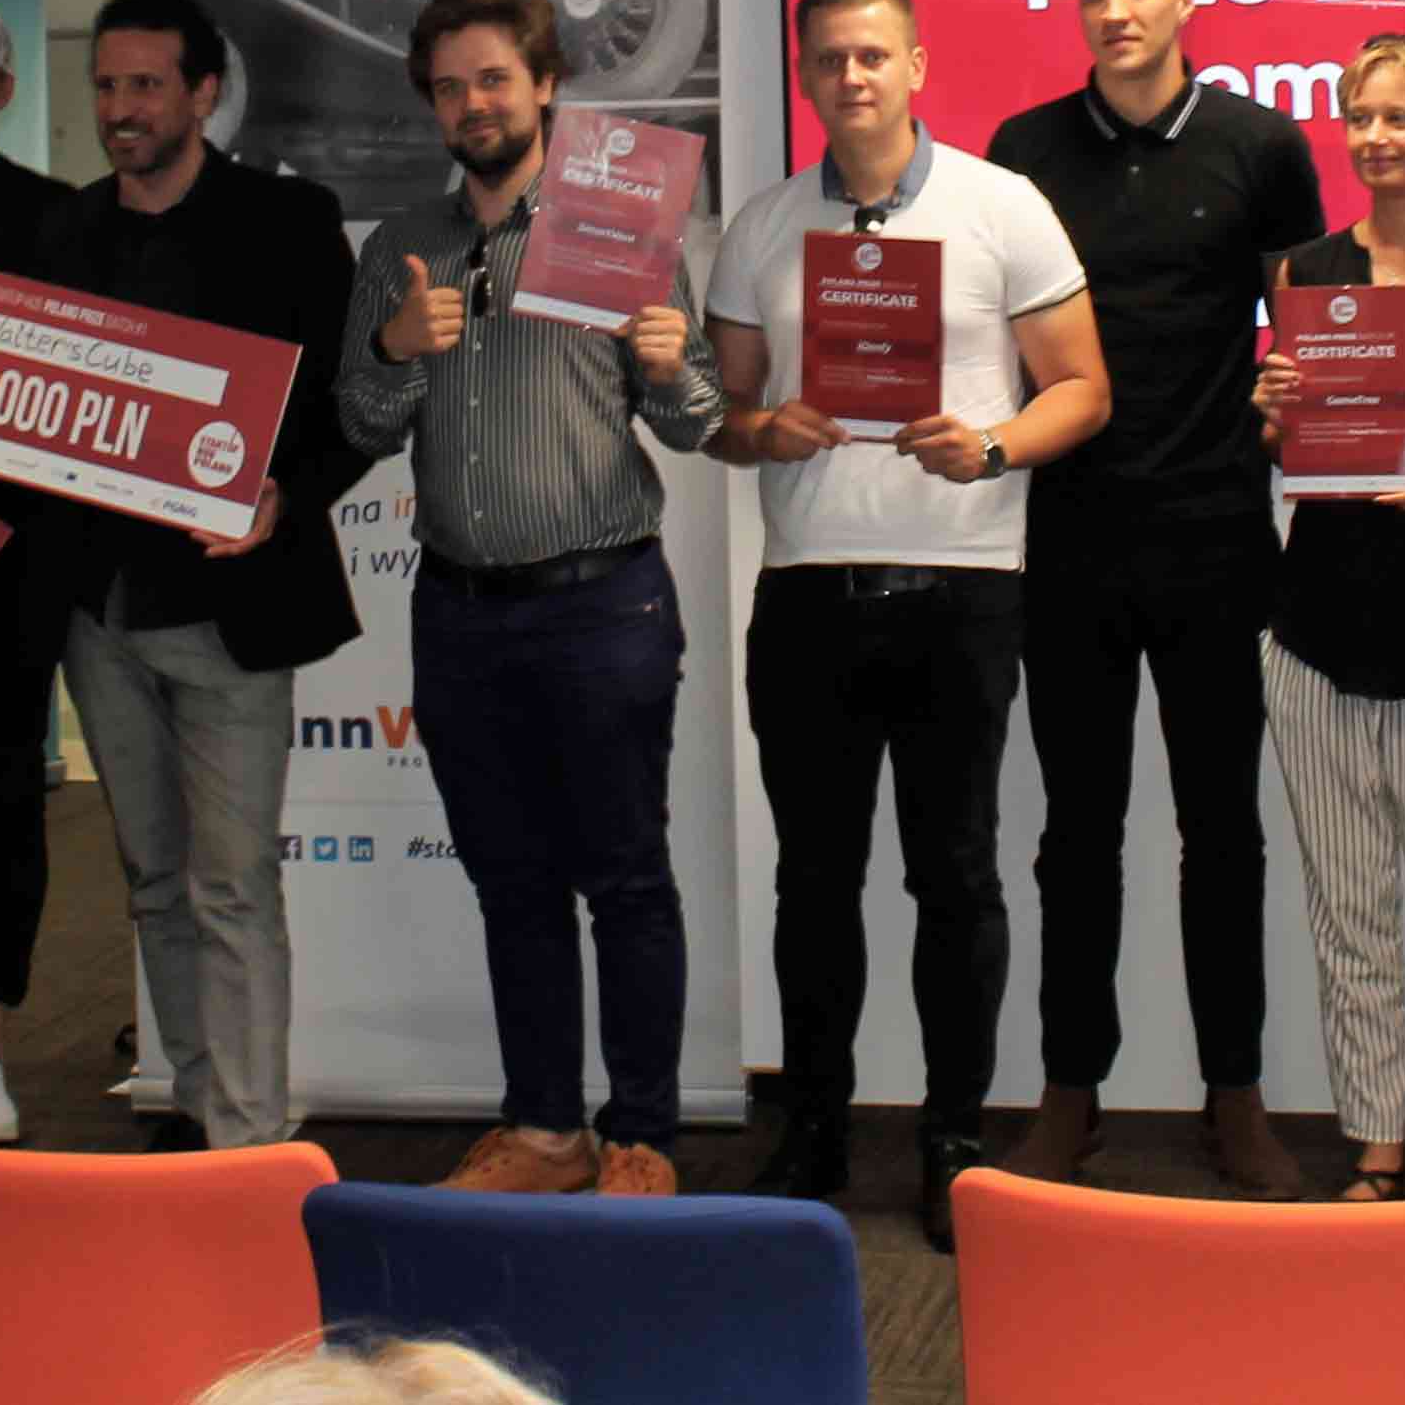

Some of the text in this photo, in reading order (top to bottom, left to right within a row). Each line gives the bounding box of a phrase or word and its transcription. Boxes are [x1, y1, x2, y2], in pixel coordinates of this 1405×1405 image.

[821, 290, 919, 308] CERTIFICATE
[1297, 344, 1396, 360] CERTIFICATE
[68, 389, 151, 460] PLN
[340, 499, 381, 526] na
